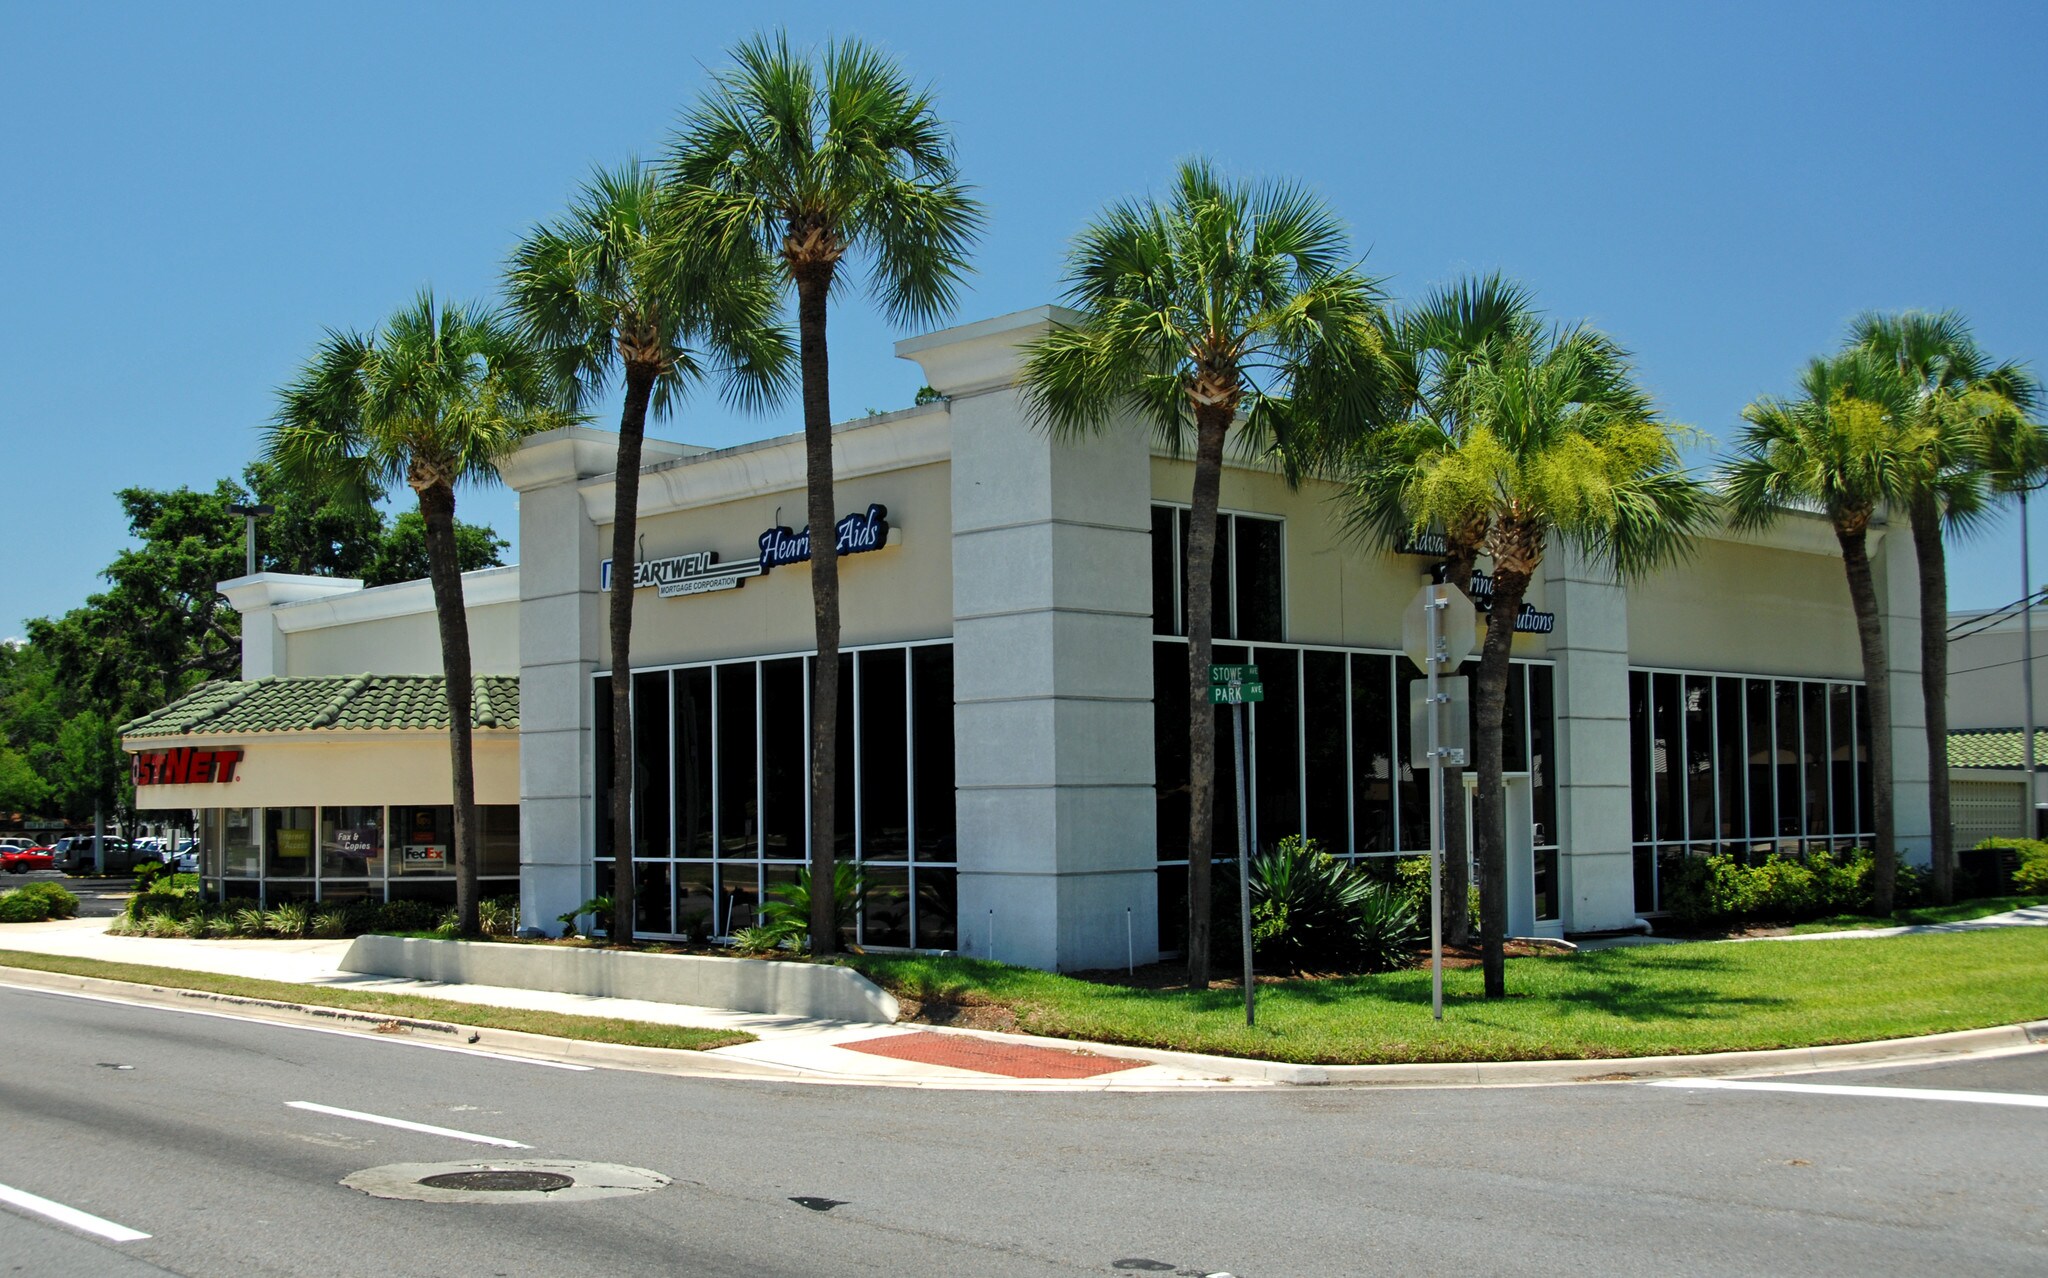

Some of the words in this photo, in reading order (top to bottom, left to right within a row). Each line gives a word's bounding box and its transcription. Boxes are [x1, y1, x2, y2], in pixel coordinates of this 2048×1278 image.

[762, 531, 812, 563] Heari
[836, 508, 877, 550] Aids
[611, 553, 714, 587] EARTWELL
[660, 582, 692, 595] MORTGAGE
[693, 577, 736, 590] CORPORATION
[1513, 605, 1553, 631] utions
[1213, 667, 1242, 681] STOWE
[1215, 687, 1242, 701] PARK
[1251, 685, 1262, 694] AVE
[338, 832, 351, 841] Fax
[353, 832, 359, 841] &
[344, 842, 370, 851] Copies
[405, 847, 444, 860] FedEx
